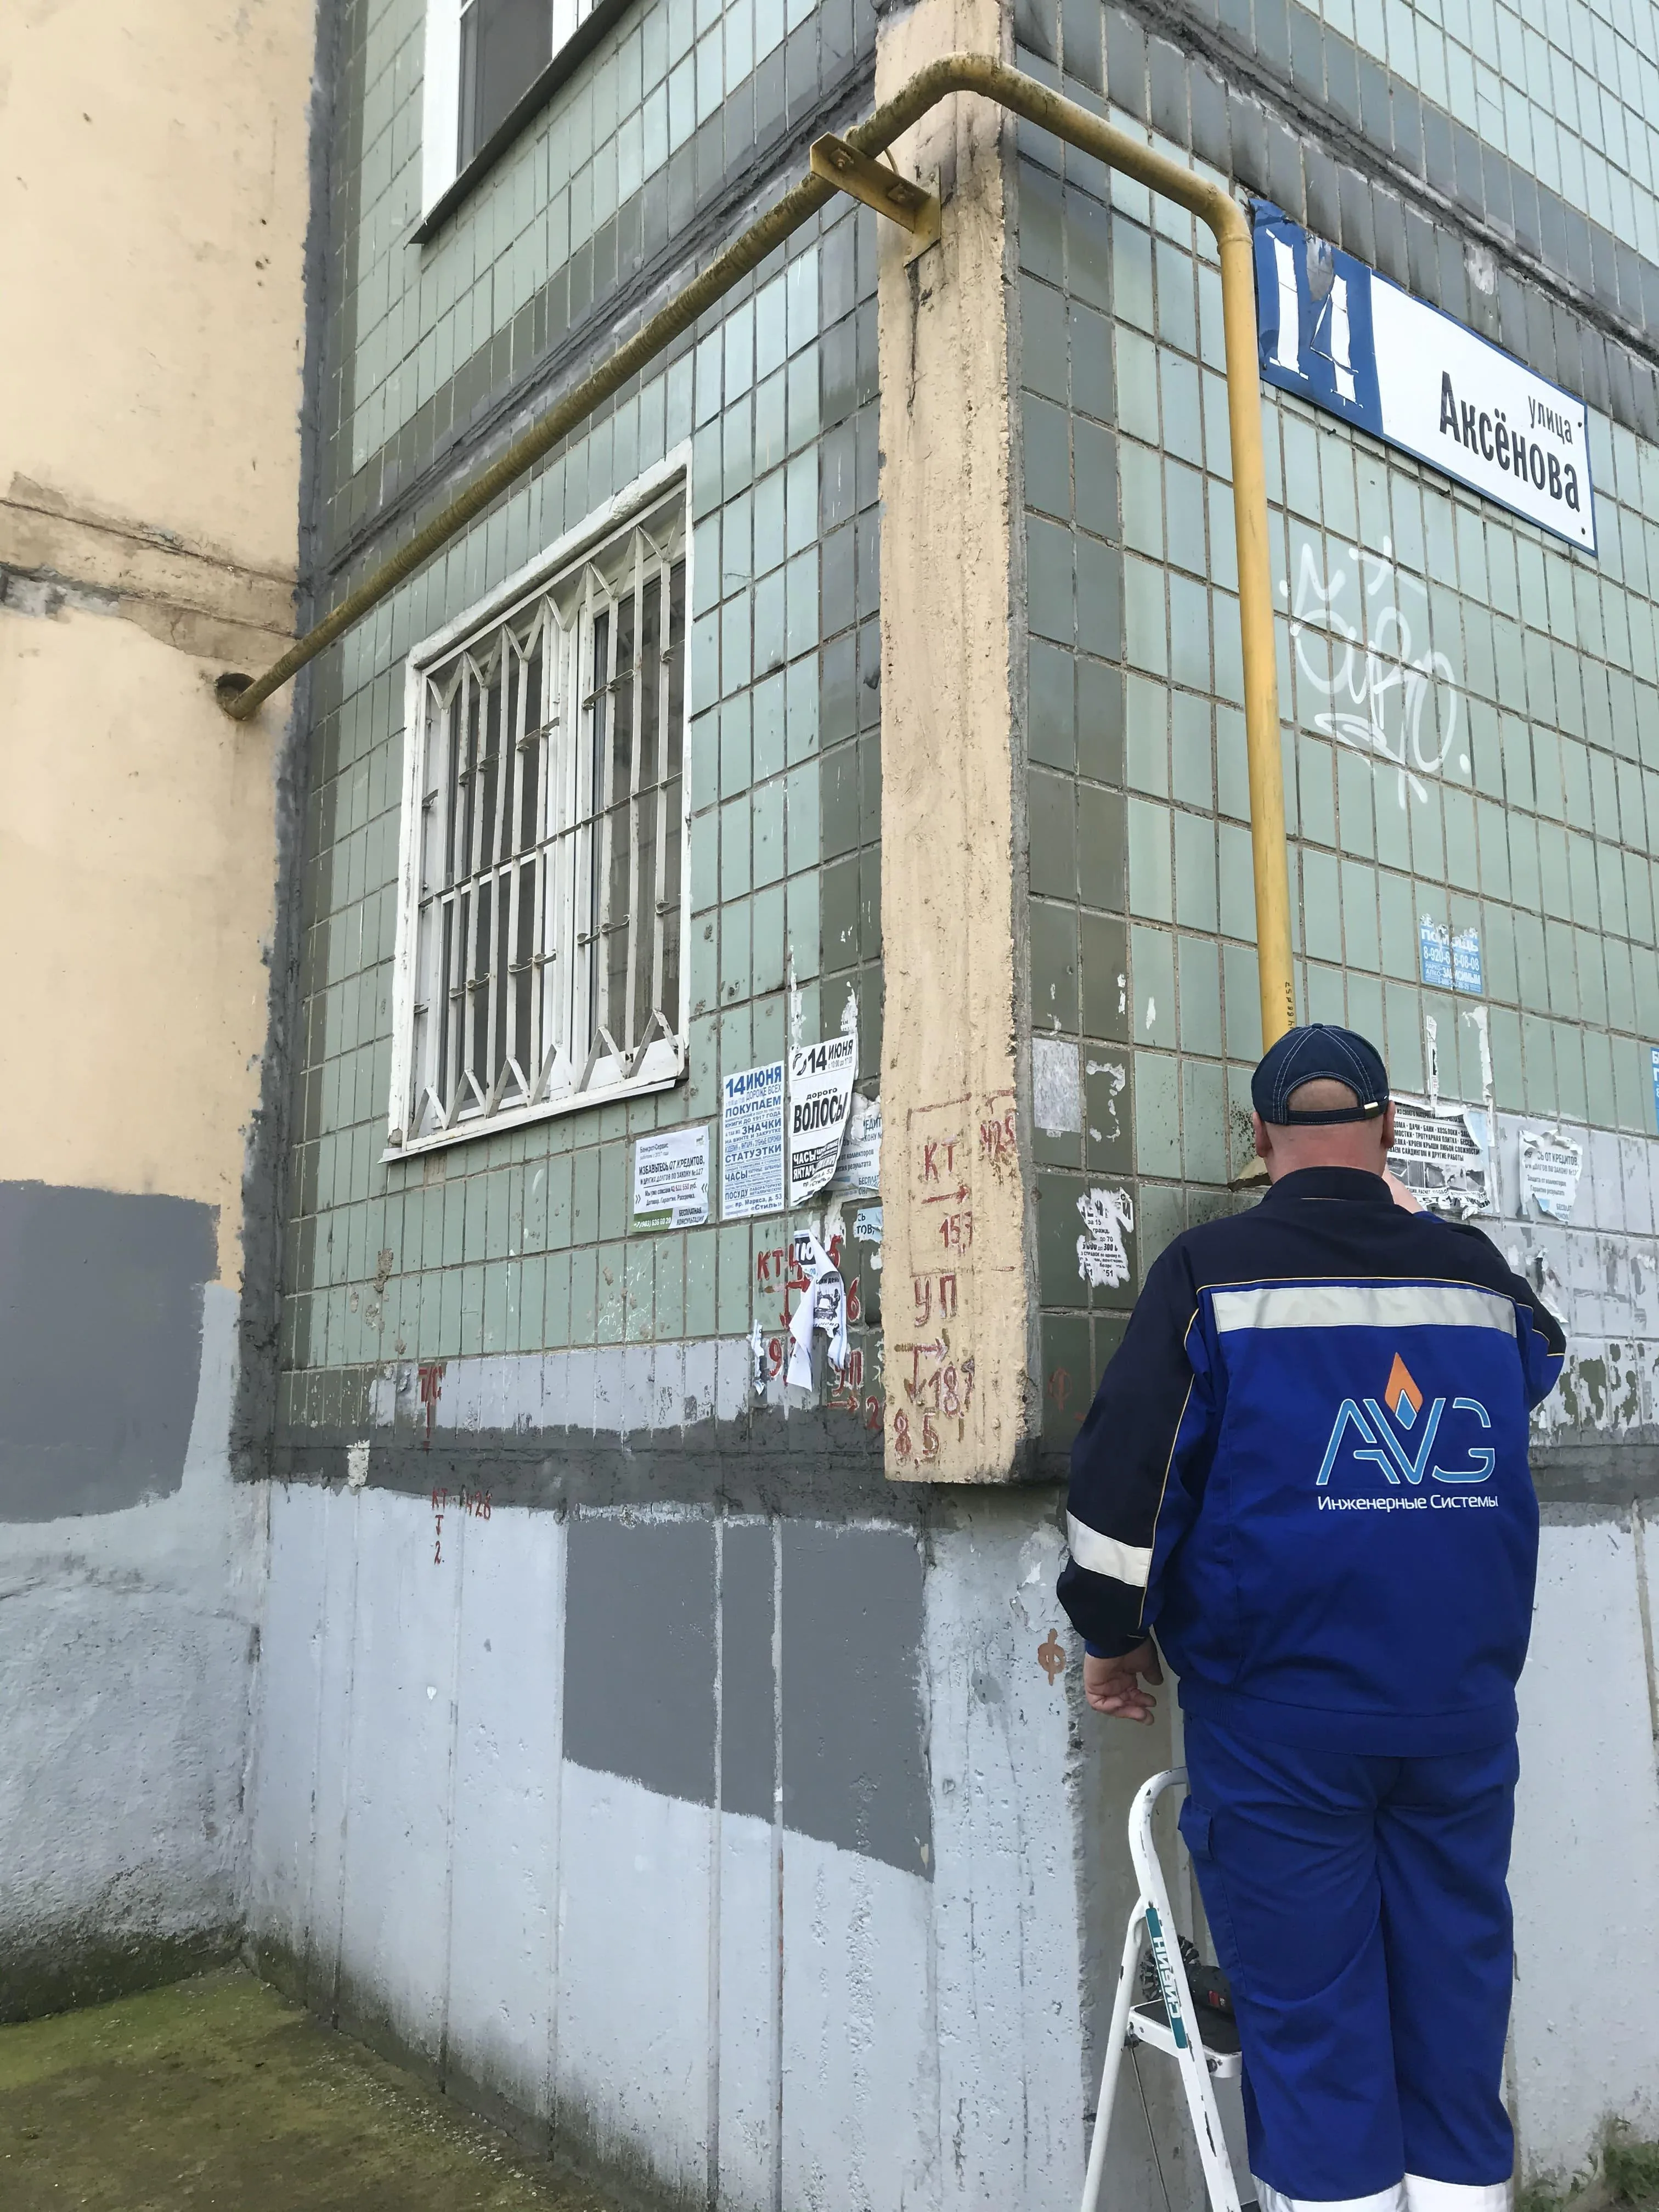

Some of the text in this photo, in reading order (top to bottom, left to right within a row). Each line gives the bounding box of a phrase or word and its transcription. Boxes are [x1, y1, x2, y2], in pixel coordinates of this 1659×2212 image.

[1266, 229, 1363, 408] 14
[1528, 394, 1573, 445] улица
[1440, 370, 1581, 513] Аксёнова
[808, 1039, 854, 1073] 14 ИЮНЯ
[726, 1065, 782, 1098] 14 ИЮНЯ
[747, 1083, 782, 1102] ДОРОЖЕ ВСЕХ
[806, 1087, 838, 1101] дорого
[725, 1095, 781, 1118] ПОКУПАЕМ
[793, 1092, 849, 1133] ВОЛОСЫ
[1402, 1109, 1416, 1118] СВОЕГО
[725, 1120, 742, 1128] КНИГИ
[742, 1118, 781, 1135] ЗНАЧКИ
[864, 1116, 882, 1131] ЕДИТ
[1409, 1122, 1420, 1131] ДАЧИ
[1437, 1127, 1458, 1136] ХОЗБЛОКИ
[755, 1127, 781, 1137] ЗАКРУТКЕ
[1394, 1129, 1457, 1144] МОСТКИ ТРОТУАРНАЯ ПЛИТКА
[725, 1143, 781, 1163] СТАТУЭТКИ
[847, 1149, 874, 1159] коллекторов
[1402, 1147, 1427, 1156] САЙДИНГОМ
[1432, 1151, 1447, 1159] ДРУГИЕ
[1447, 1153, 1464, 1161] РАБОТЫ
[1408, 1139, 1423, 1148] КРОЕМ
[1423, 1142, 1439, 1150] КРЫШИ
[1440, 1143, 1454, 1153] ЛЮБОЙ
[1454, 1146, 1480, 1155] СЛОЖНОСТИ
[793, 1148, 817, 1164] ЧАСЫ
[924, 1136, 960, 1183] КТ
[1545, 1152, 1551, 1161] ОТ
[1552, 1153, 1579, 1167] КРЕДИТОВ,
[639, 1155, 705, 1176] ИЗБАВЬТЕСЬ ОТ КРЕДИТОВ,
[848, 1161, 871, 1172] результата
[643, 1176, 656, 1185] ДРУГИХ
[656, 1173, 670, 1182] ДОЛГОВ
[676, 1170, 691, 1178] ЗАКОНУ
[725, 1170, 748, 1182] ЧАСЫ
[859, 1175, 879, 1184] БЕСПЛАТ
[725, 1189, 748, 1200] ПОСУДУ
[745, 1197, 767, 1205] Маркса,
[679, 1206, 702, 1217] БЕСПЛАТНАЯ
[751, 1202, 782, 1211] «Стиль»
[857, 1214, 866, 1222] СЬ
[856, 1224, 875, 1235] ТОВ,
[1103, 1243, 1114, 1251] 300
[757, 1246, 784, 1282] КТ
[914, 1273, 957, 1327] УП
[1317, 1493, 1499, 1513] Инженерные Системы
[1152, 1936, 1181, 2019] СИБИН
